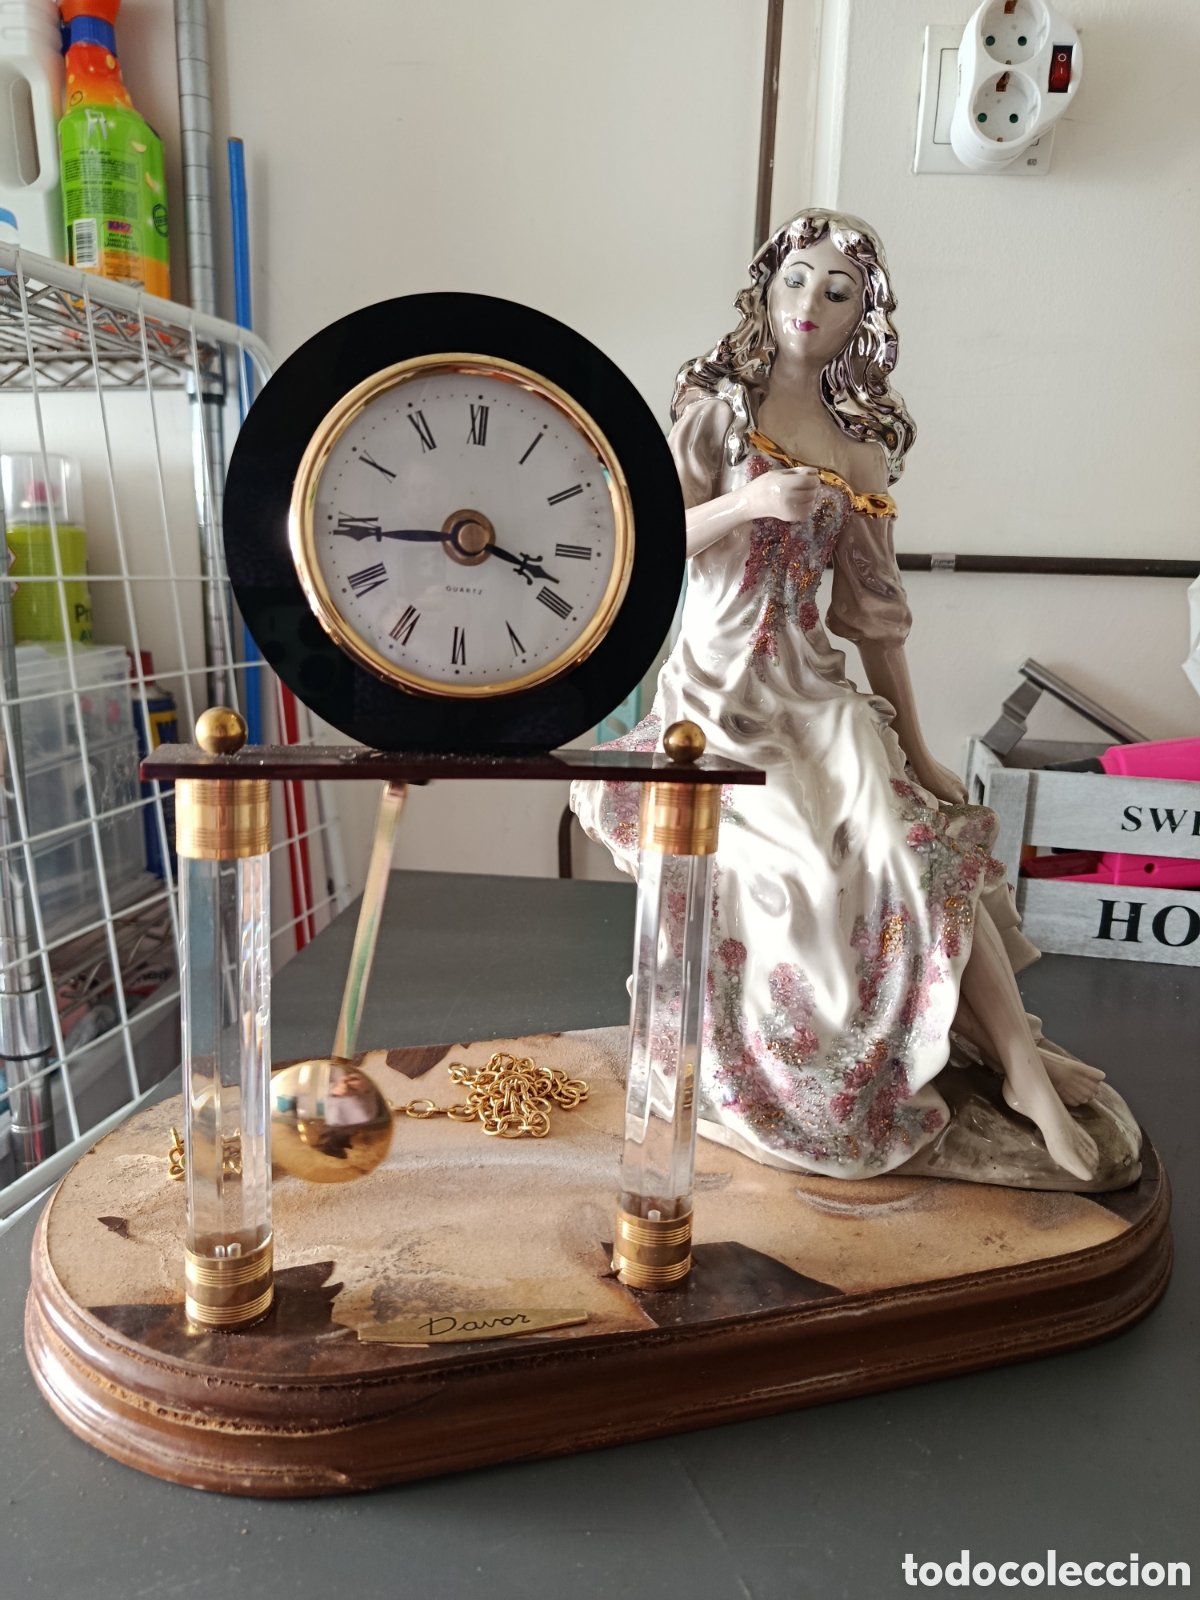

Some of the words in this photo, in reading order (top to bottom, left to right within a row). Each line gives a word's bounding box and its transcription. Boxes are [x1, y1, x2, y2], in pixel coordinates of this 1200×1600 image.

[407, 410, 437, 453] XI
[466, 403, 490, 446] XII
[359, 450, 397, 483] X
[446, 585, 483, 595] QUARTZ
[1092, 899, 1200, 947] HO
[418, 1313, 530, 1335] Davor
